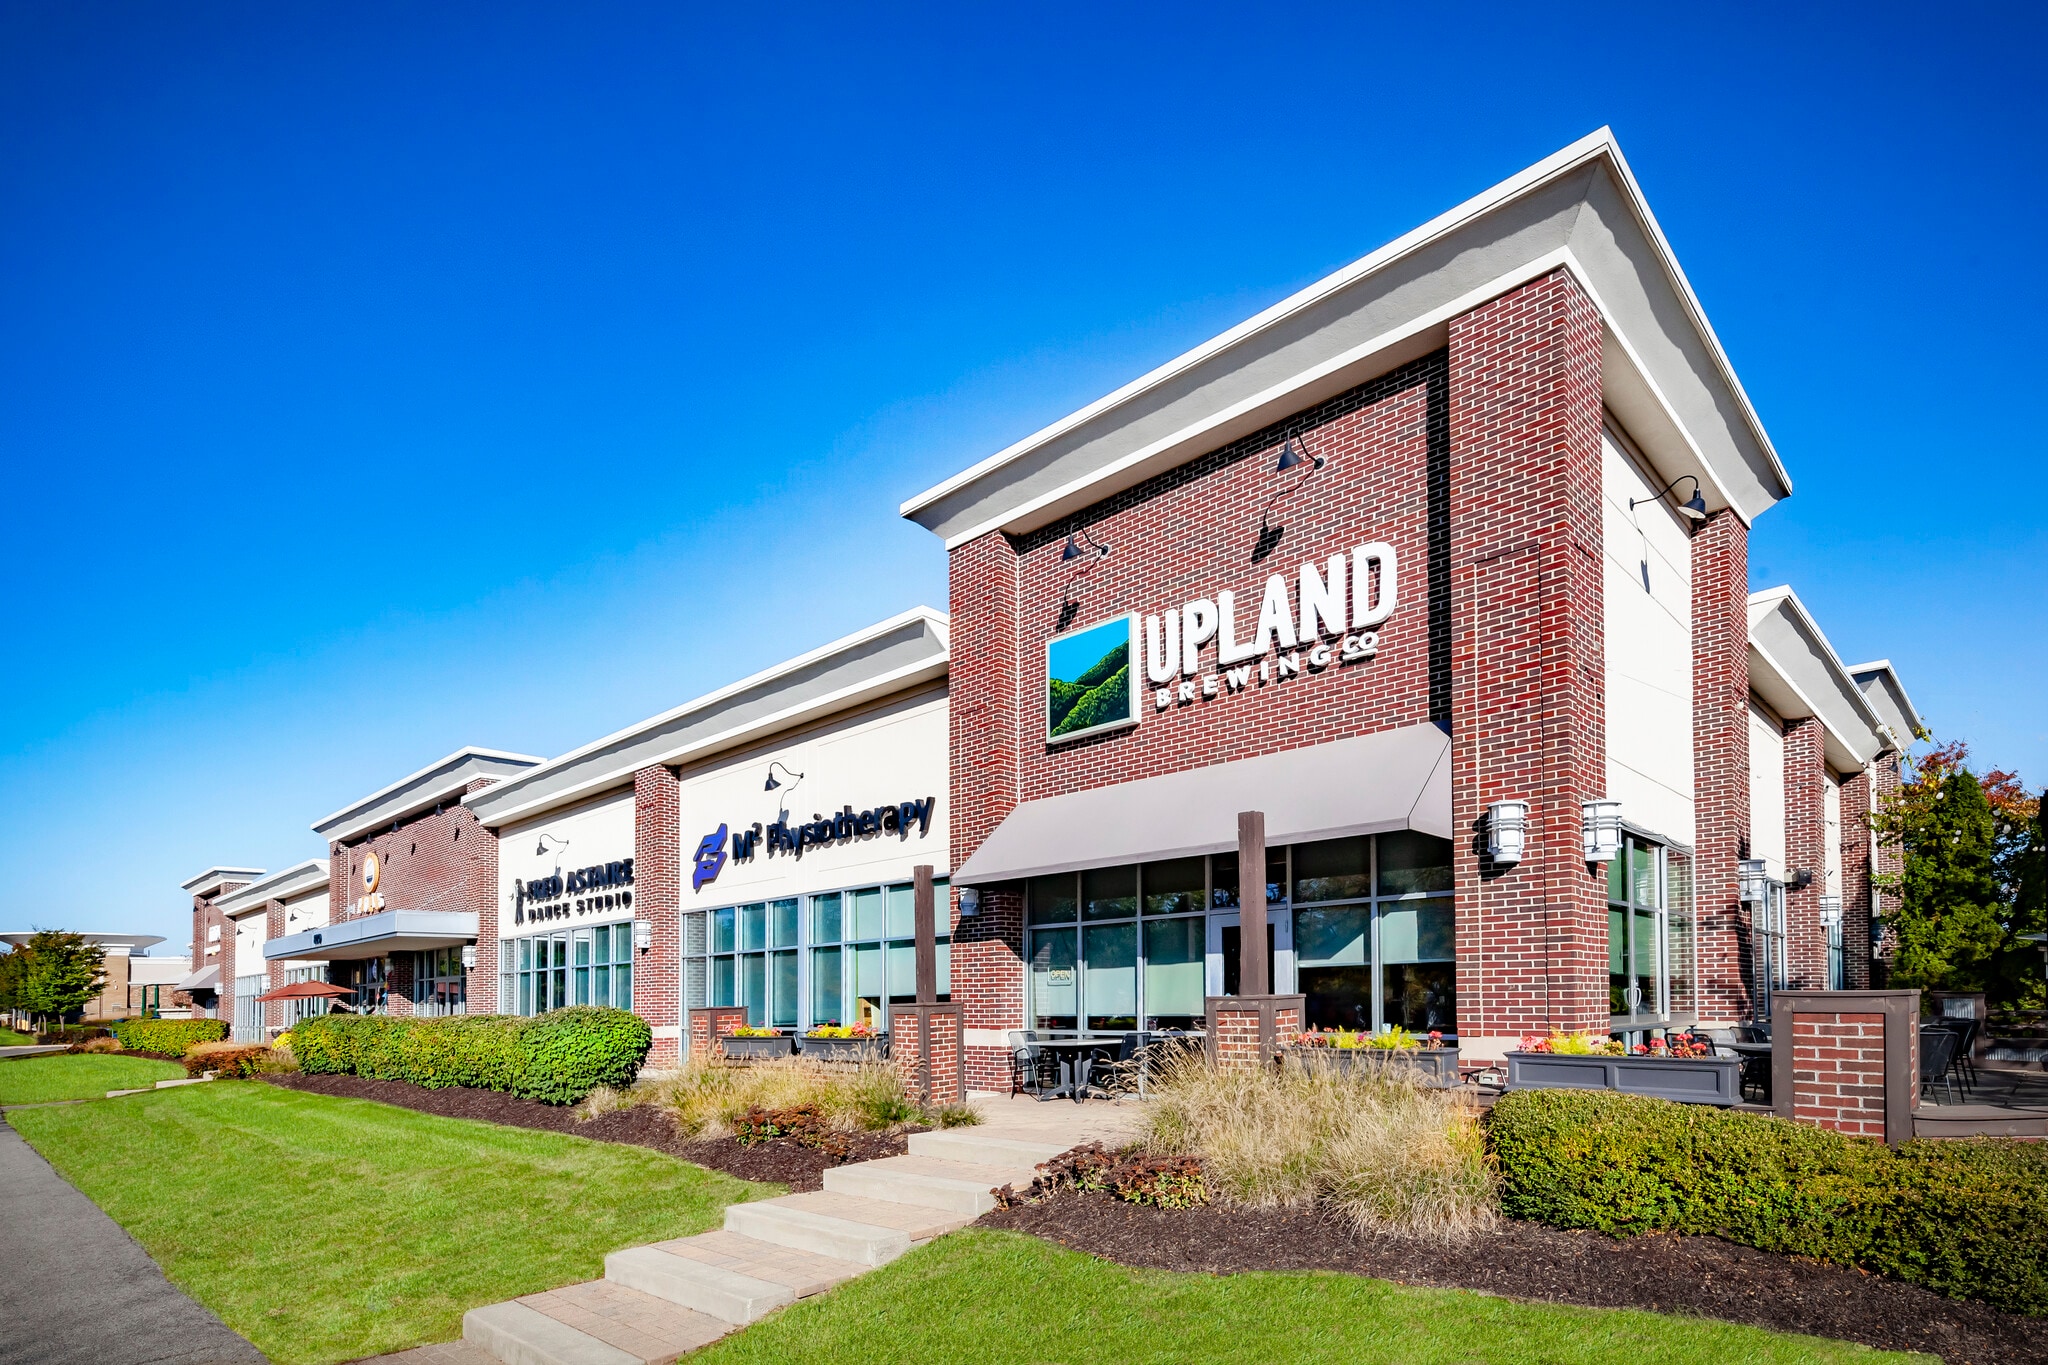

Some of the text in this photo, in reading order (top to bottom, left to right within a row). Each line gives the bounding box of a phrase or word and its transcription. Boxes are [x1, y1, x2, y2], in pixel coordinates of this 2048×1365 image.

[1146, 541, 1397, 683] UPLAND
[1156, 631, 1379, 708] BREWING CO
[766, 796, 935, 861] Physiotherapy
[526, 858, 634, 901] FRED ASTAIRE
[528, 891, 633, 921] DANCE STUDIO
[1050, 970, 1070, 980] OPEN
